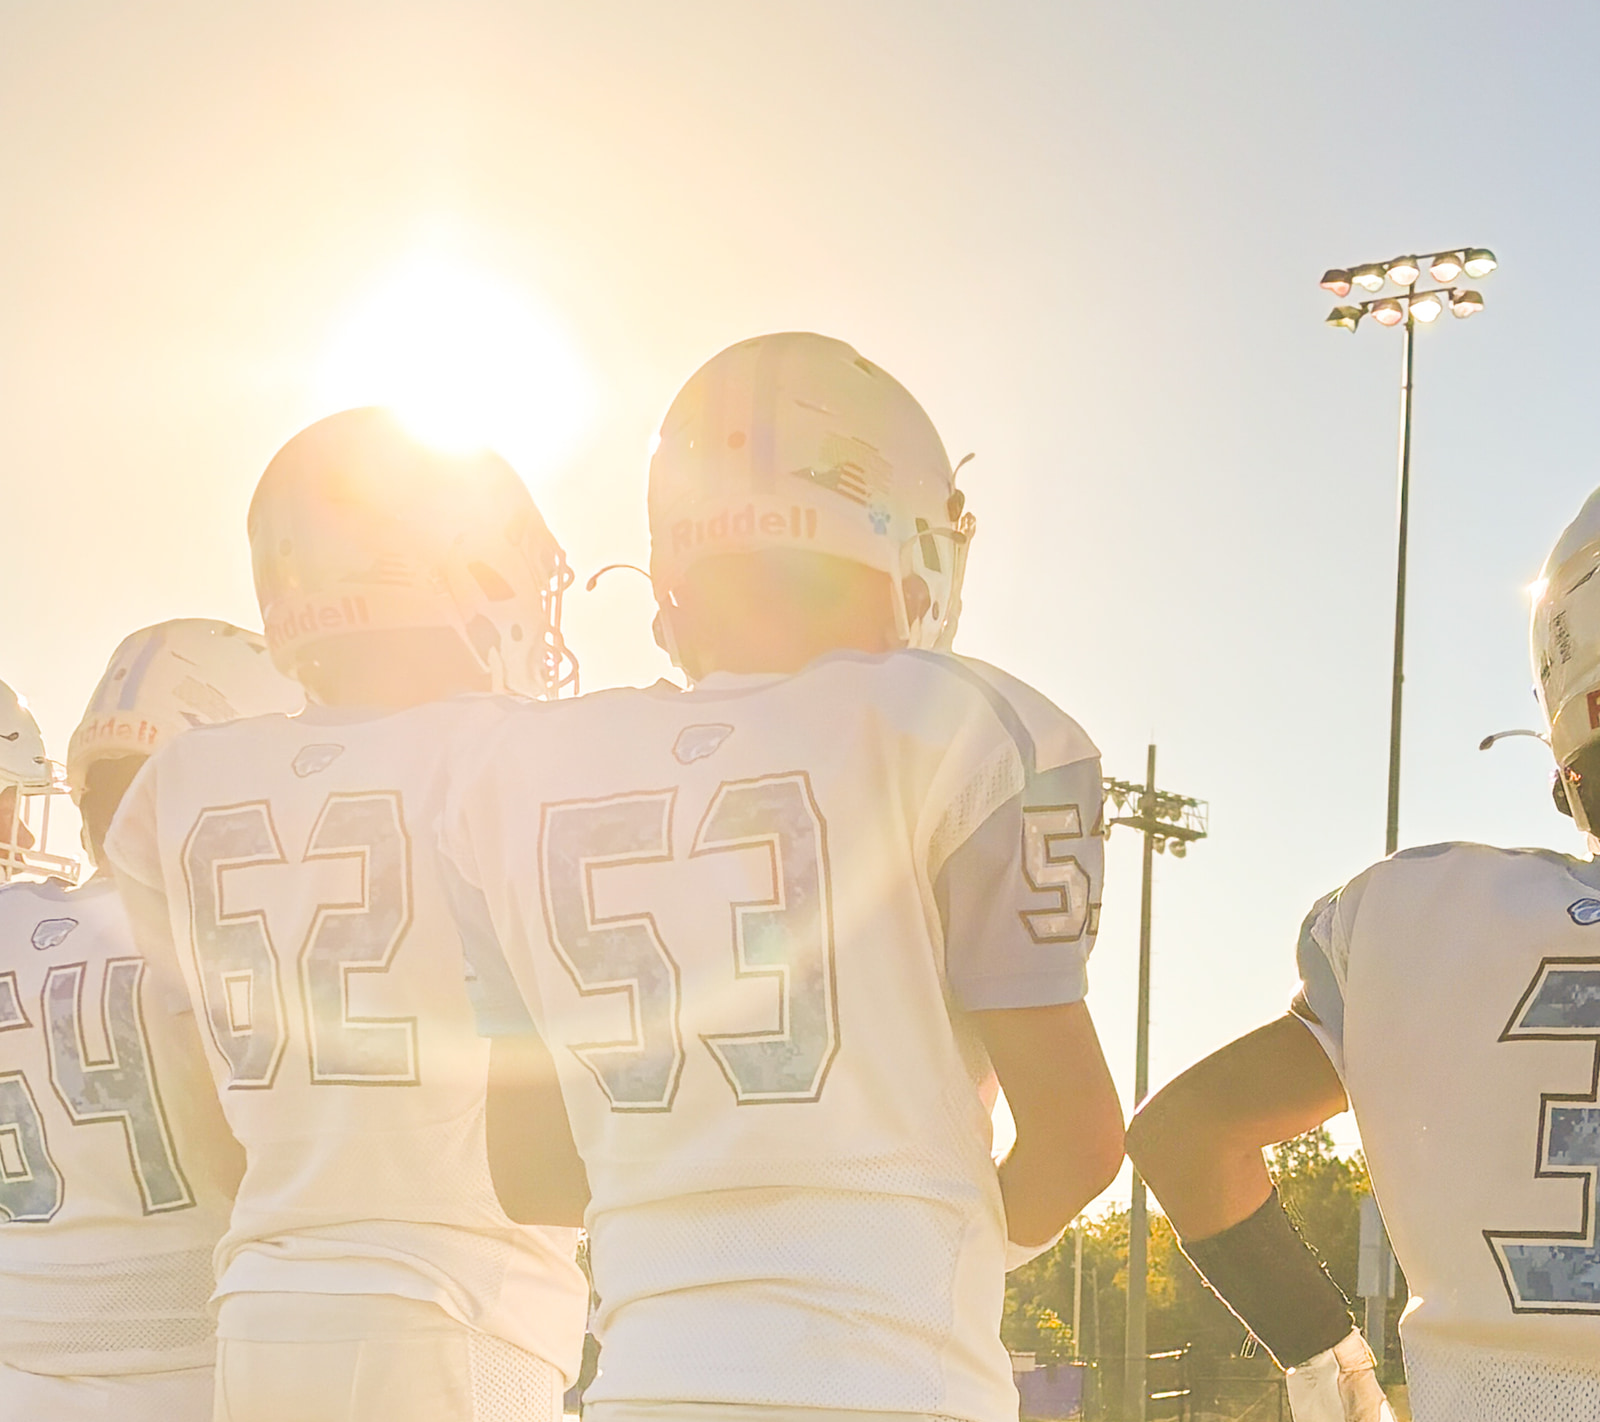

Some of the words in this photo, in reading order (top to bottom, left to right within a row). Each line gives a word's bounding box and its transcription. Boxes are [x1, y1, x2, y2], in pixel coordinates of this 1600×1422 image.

[671, 502, 818, 557] Riddell
[181, 789, 421, 1091] 62
[538, 769, 842, 1114] 53
[1018, 803, 1102, 944] 5
